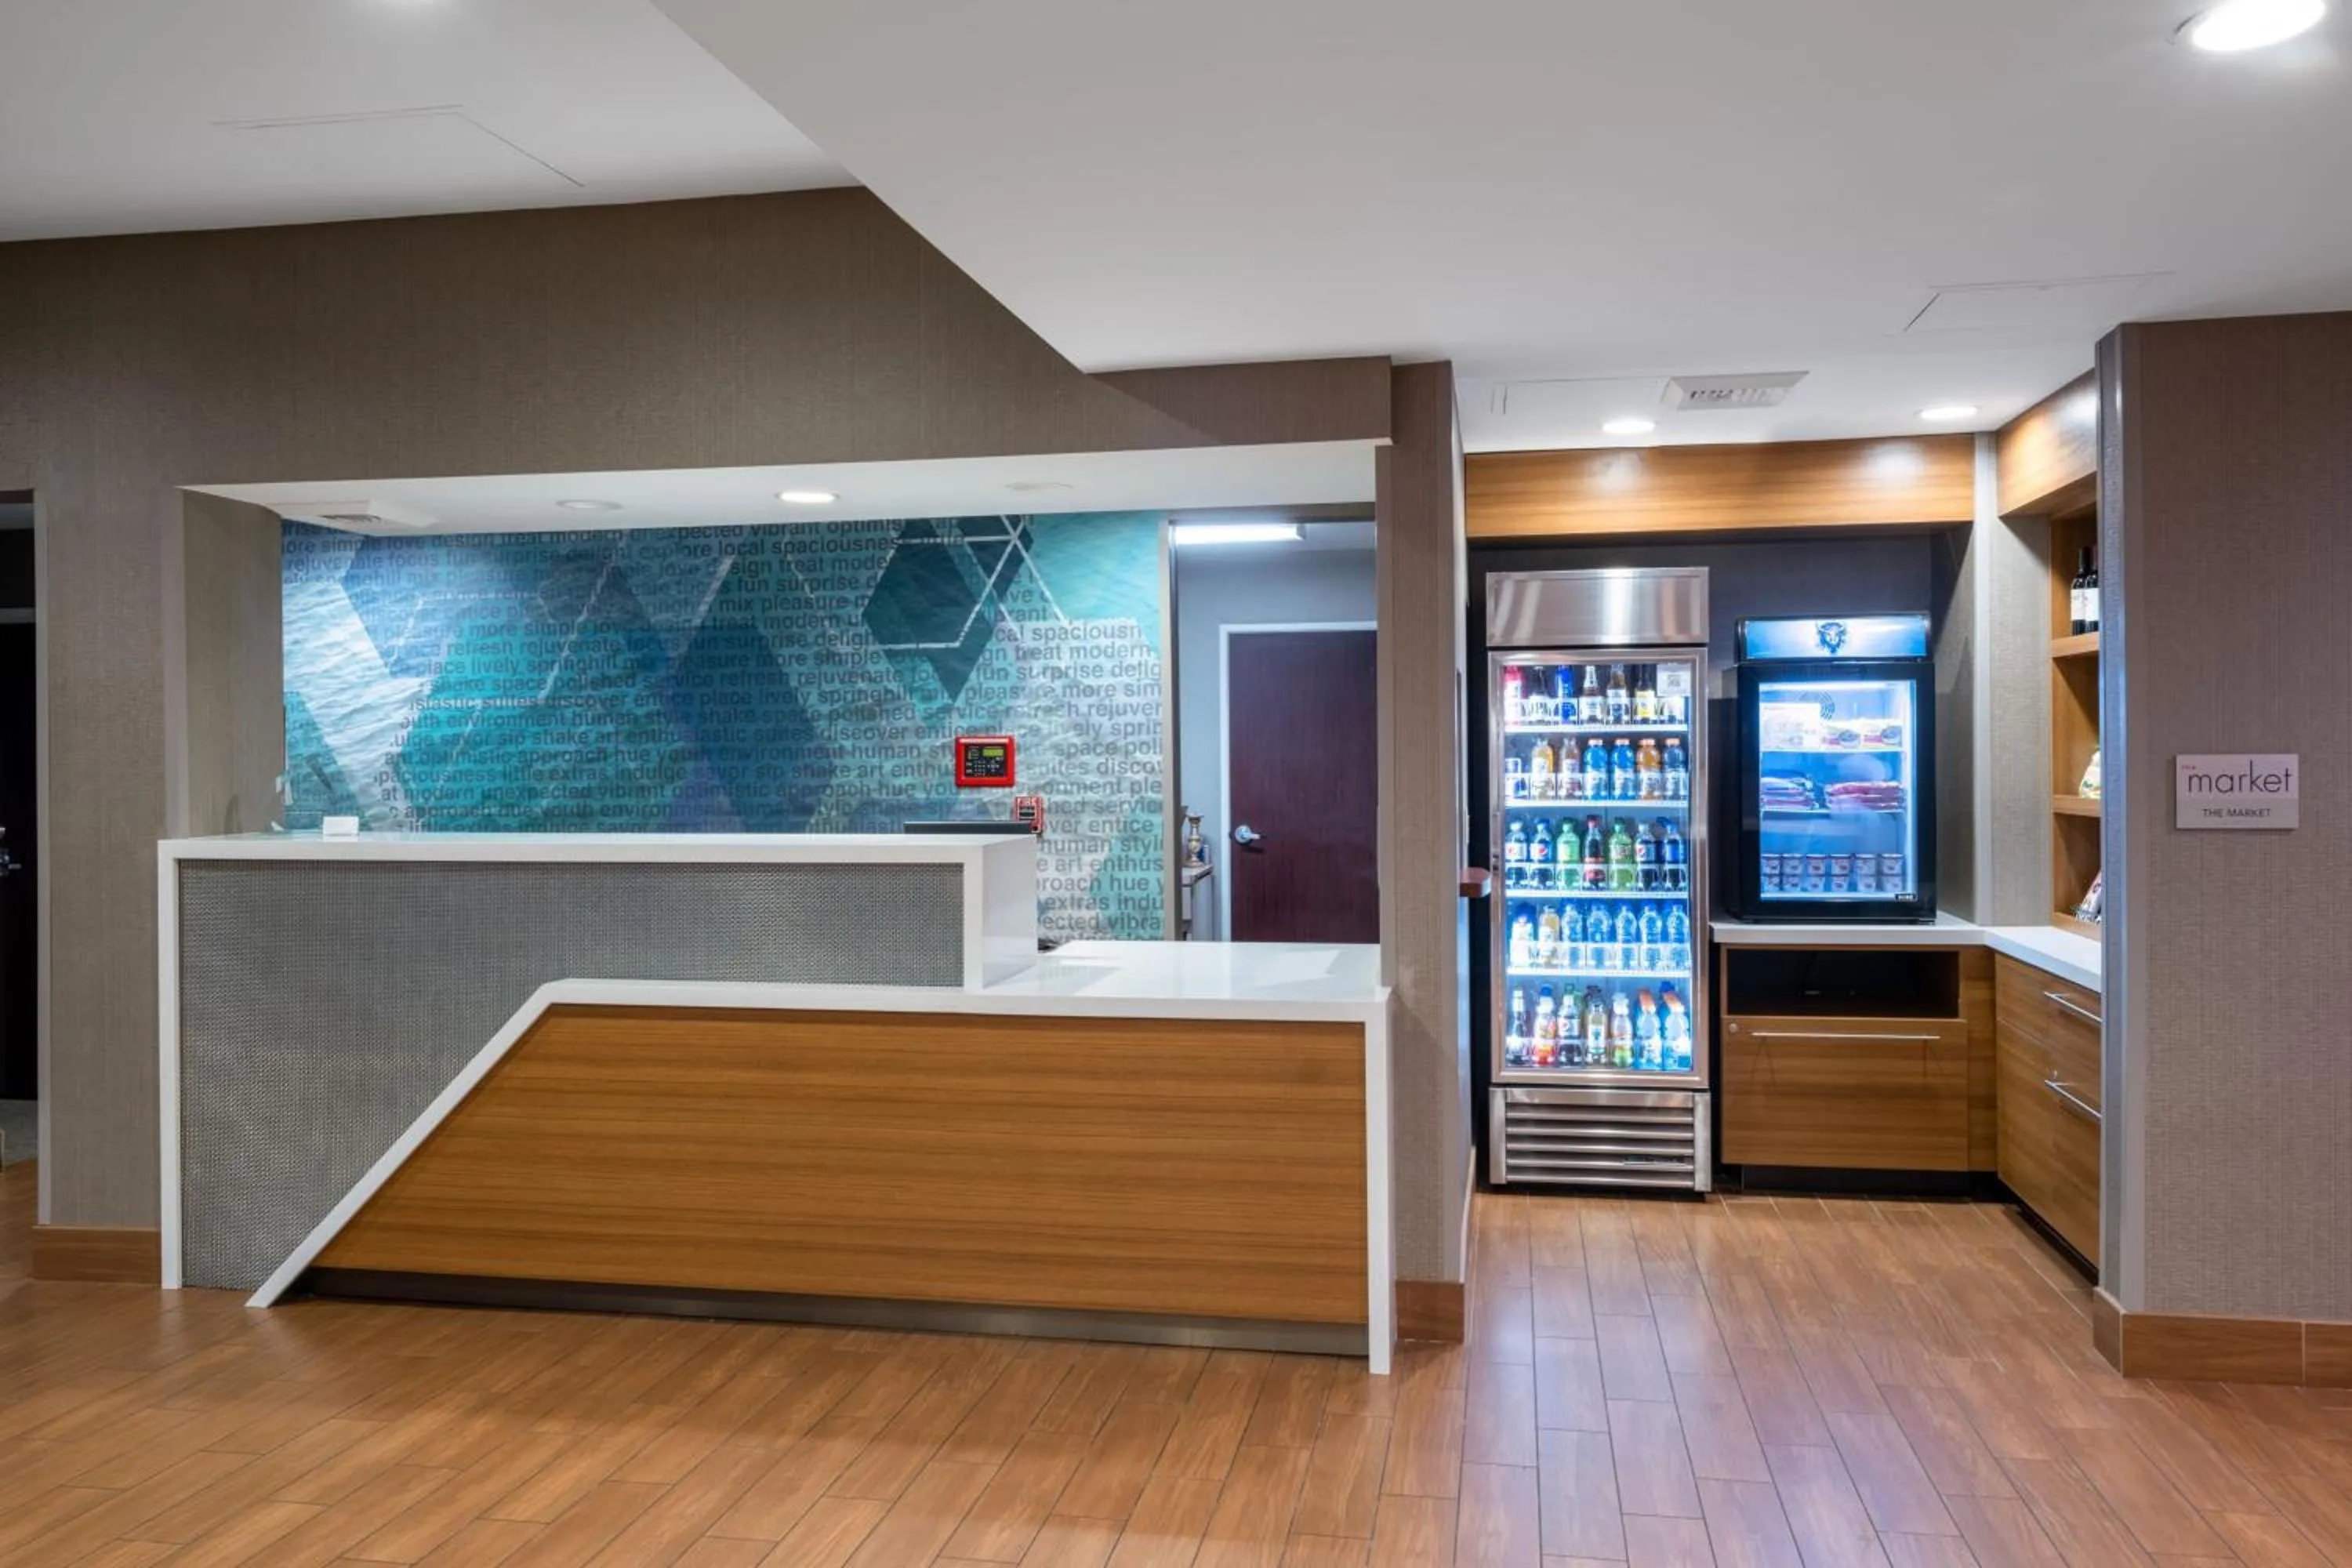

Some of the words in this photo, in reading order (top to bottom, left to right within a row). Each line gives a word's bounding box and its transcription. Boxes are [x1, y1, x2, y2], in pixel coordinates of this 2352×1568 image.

[283, 539, 315, 554] ore
[630, 527, 742, 544] unexpected
[750, 522, 819, 538] vibrant
[718, 539, 764, 557] local
[739, 578, 769, 593] fun
[777, 575, 858, 595] surprise
[719, 594, 753, 612] mix
[761, 593, 851, 615] pleasure
[765, 610, 840, 629] modern
[724, 630, 811, 651] surprise
[1069, 641, 1151, 660] modern
[472, 656, 520, 678] lively
[756, 651, 808, 668] more
[814, 647, 881, 670] simple
[491, 675, 546, 695] space
[797, 664, 903, 688] rejuvenate
[1062, 681, 1116, 699] more
[759, 684, 811, 707] lively
[446, 709, 565, 729] environment
[572, 706, 637, 726] human
[533, 727, 589, 746] shake
[821, 720, 909, 742] discover
[517, 745, 608, 768] approach
[614, 742, 650, 762] hue
[851, 739, 921, 760] human
[1054, 740, 1117, 760] space
[550, 763, 608, 782] extras
[615, 760, 687, 786] indulge
[857, 758, 887, 779] art
[2188, 759, 2292, 793] market
[879, 775, 916, 797] hue
[2202, 808, 2223, 818] THE
[2226, 808, 2271, 818] MARKET
[1089, 816, 1154, 833] entice
[1040, 835, 1112, 853] human
[1055, 855, 1083, 872] art
[1090, 853, 1163, 872] enthus
[1036, 873, 1101, 891] roach
[1110, 873, 1149, 891] hue
[1108, 910, 1161, 931] vibra
